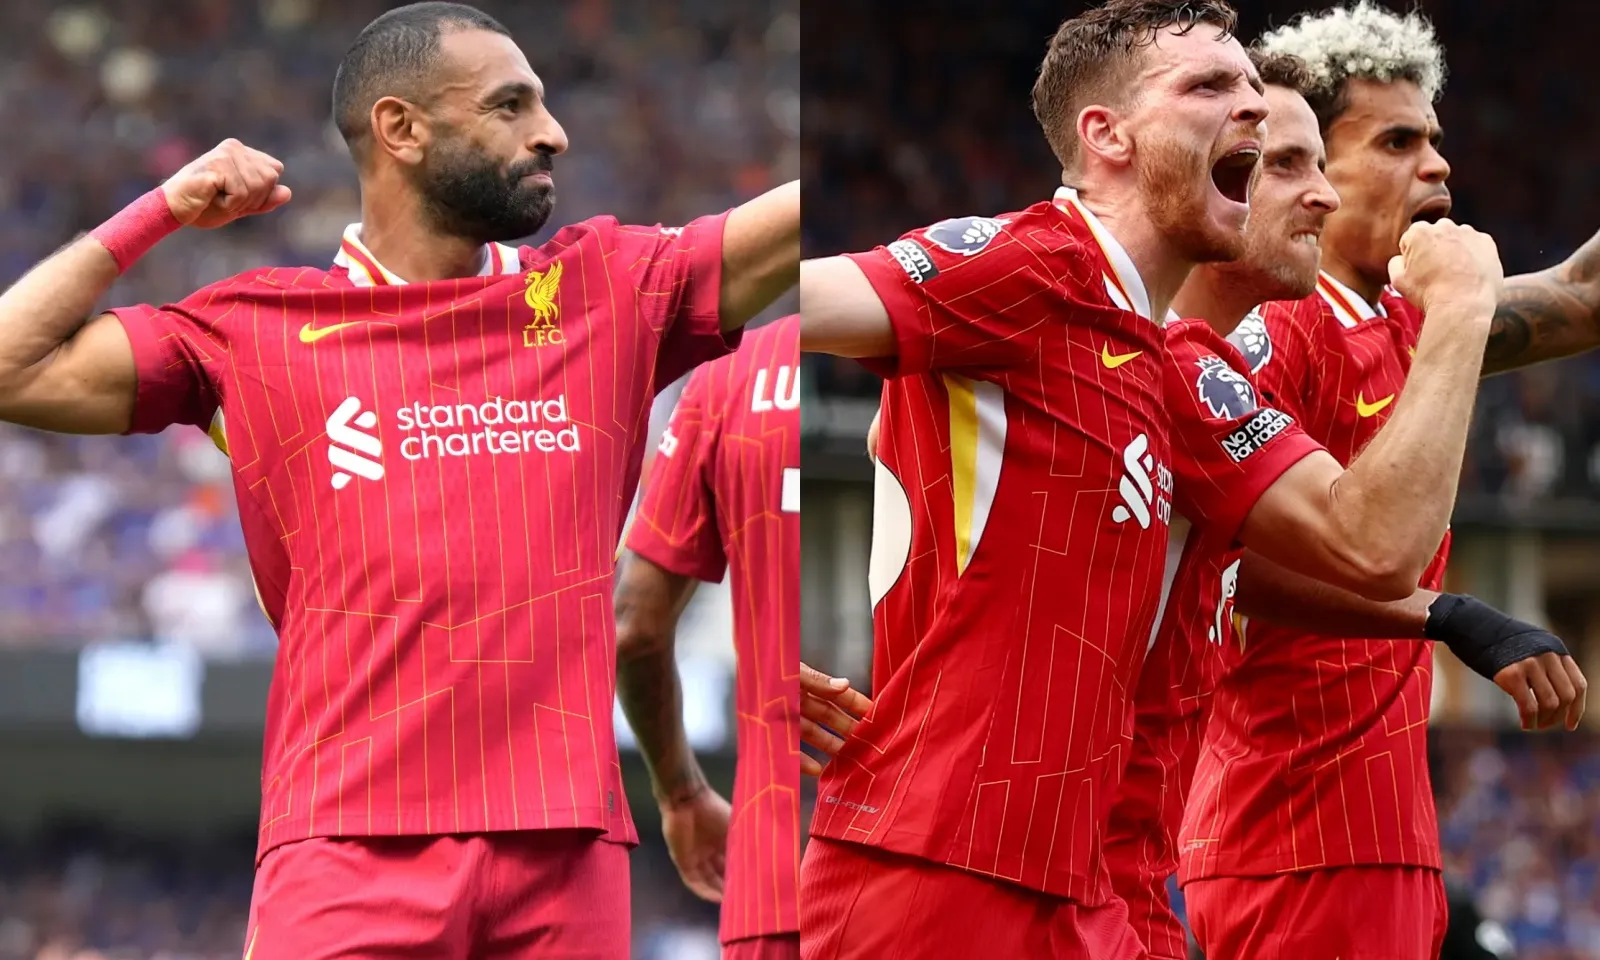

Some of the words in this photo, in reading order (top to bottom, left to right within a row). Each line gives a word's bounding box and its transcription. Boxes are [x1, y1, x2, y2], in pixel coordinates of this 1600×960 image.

[522, 329, 567, 347] L.F.C.
[752, 365, 800, 412] LU
[396, 394, 567, 430] standard
[400, 424, 581, 460] chartered
[1221, 431, 1247, 454] No
[1245, 408, 1280, 436] room
[1230, 440, 1254, 463] for
